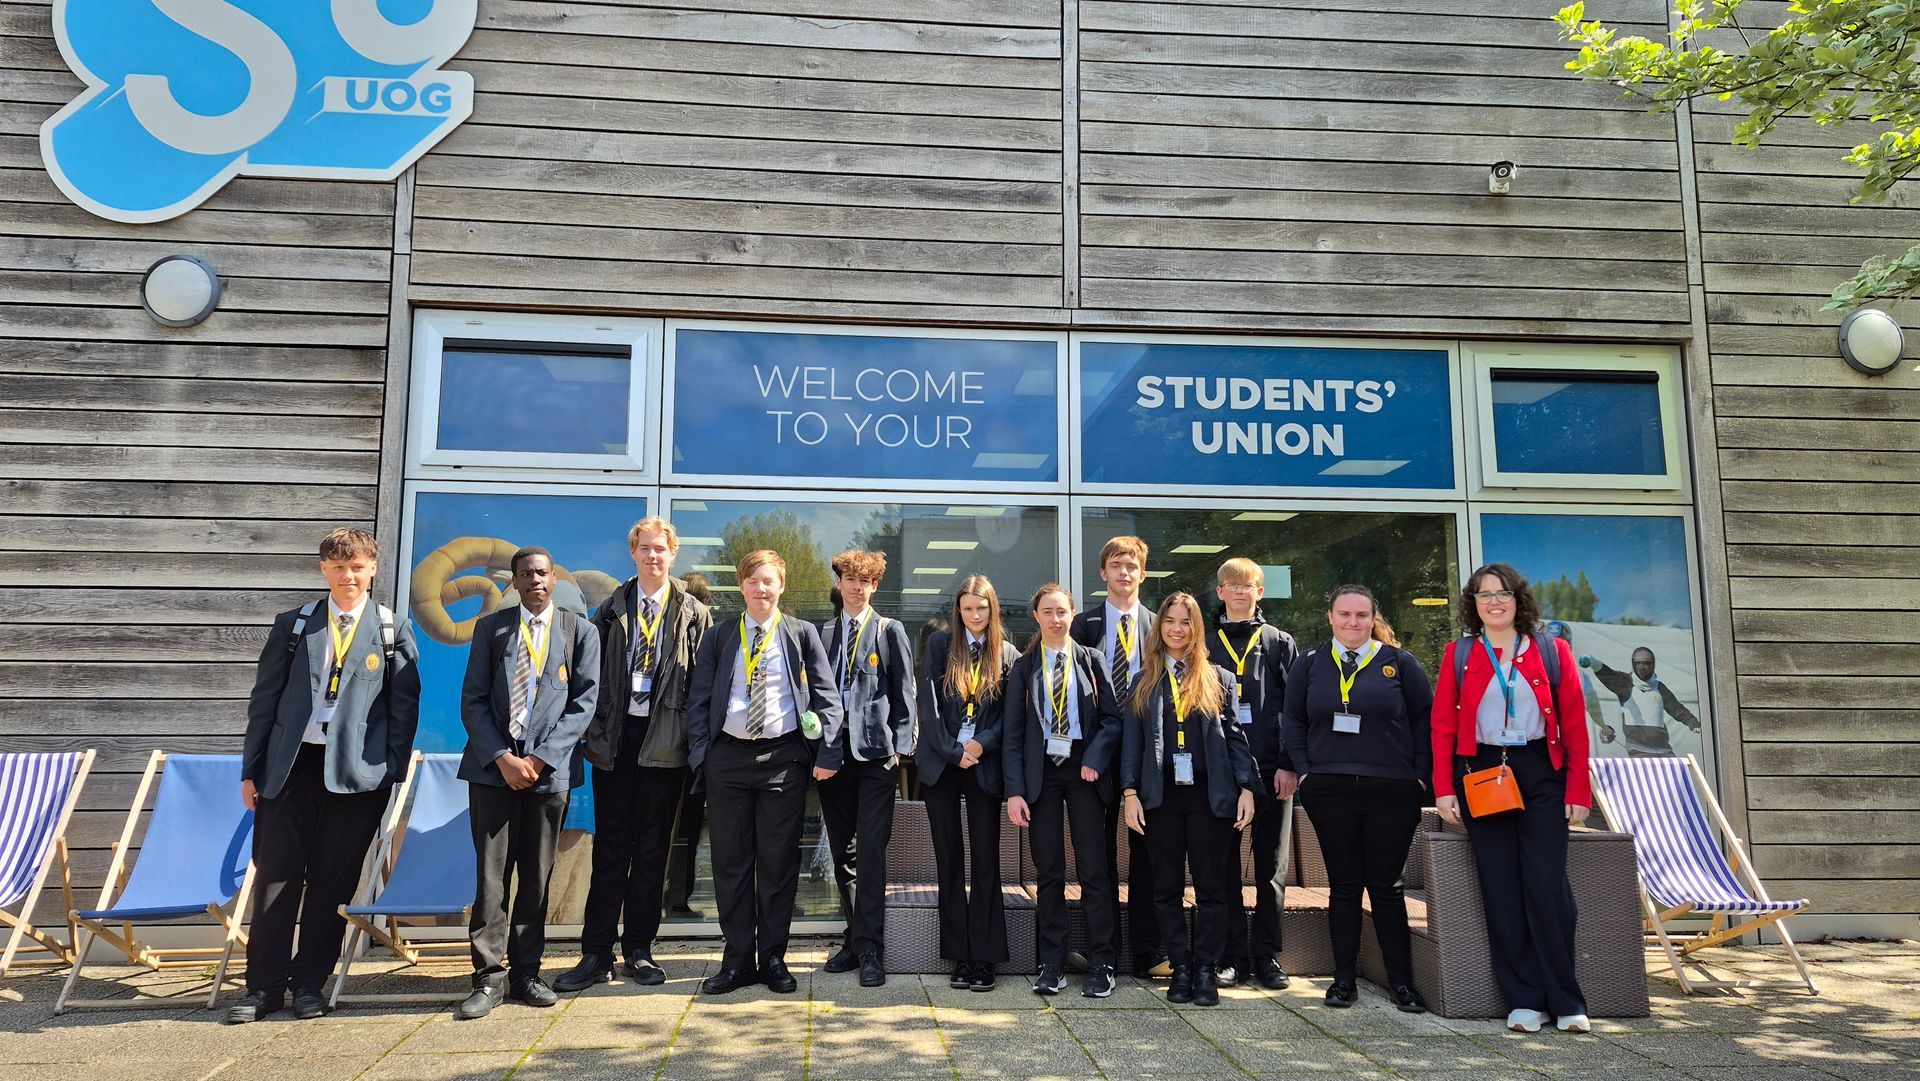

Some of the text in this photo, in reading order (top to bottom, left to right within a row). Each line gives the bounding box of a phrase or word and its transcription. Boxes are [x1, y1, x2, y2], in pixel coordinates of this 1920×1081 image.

[345, 79, 452, 114] UOG
[753, 364, 985, 405] WELCOME
[1136, 375, 1396, 413] STUDENTS’
[766, 410, 972, 449] TO YOUR
[1192, 421, 1344, 456] UNION
